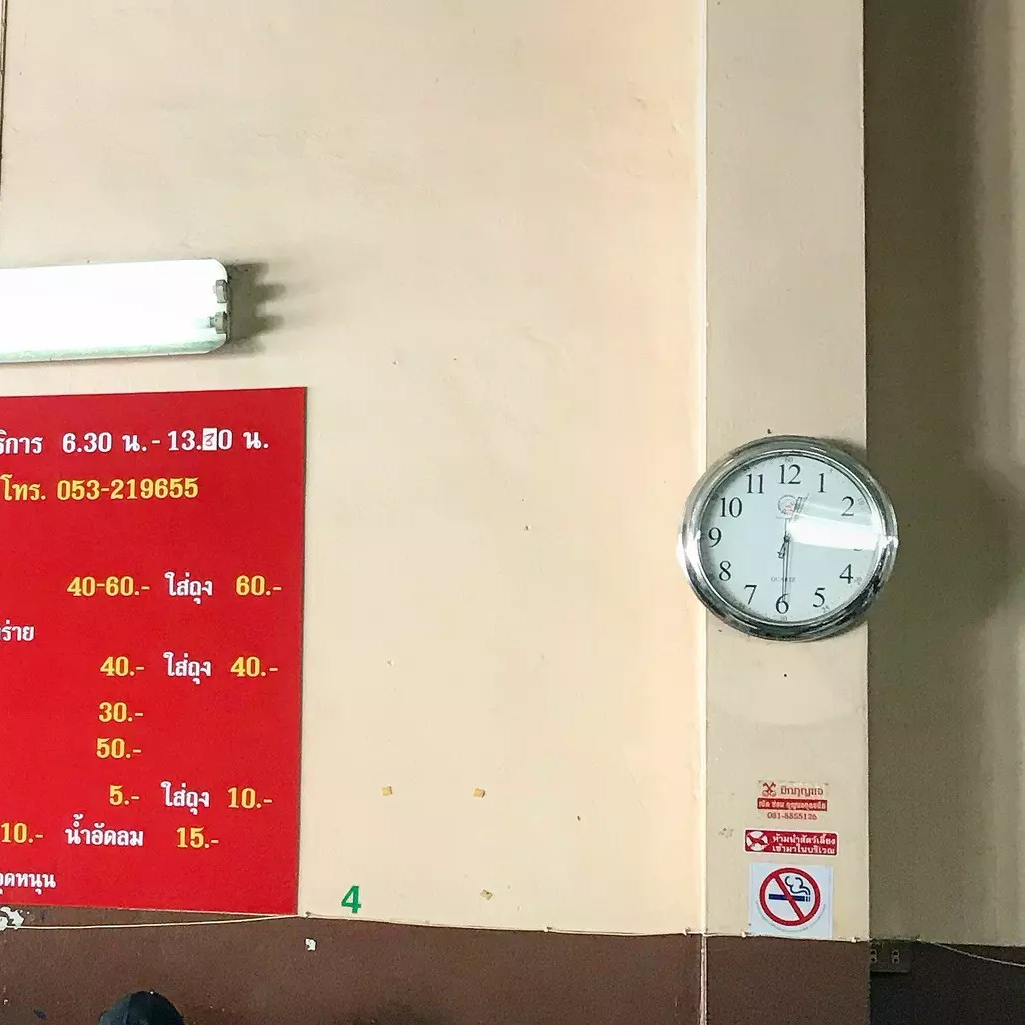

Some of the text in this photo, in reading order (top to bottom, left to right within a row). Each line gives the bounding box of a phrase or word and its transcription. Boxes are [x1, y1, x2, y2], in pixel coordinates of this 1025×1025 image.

[63, 432, 111, 453] 6.30
[746, 473, 764, 494] 11
[778, 464, 801, 485] 12
[818, 472, 826, 493] 1
[0, 474, 198, 500] โทร. 053-219655
[720, 497, 742, 518] 10
[841, 496, 855, 517] 2
[708, 527, 722, 548] 9
[718, 560, 732, 582] 8
[839, 563, 854, 584] 4
[165, 572, 212, 605] ใส่ถุง
[743, 584, 757, 605] 7
[812, 587, 826, 608] 5
[775, 593, 789, 614] 6
[163, 652, 211, 685] ใส่ถุง
[161, 781, 209, 815] ใส่ถุง
[65, 814, 143, 846] น้ำอัดลม
[341, 885, 362, 913] 4
